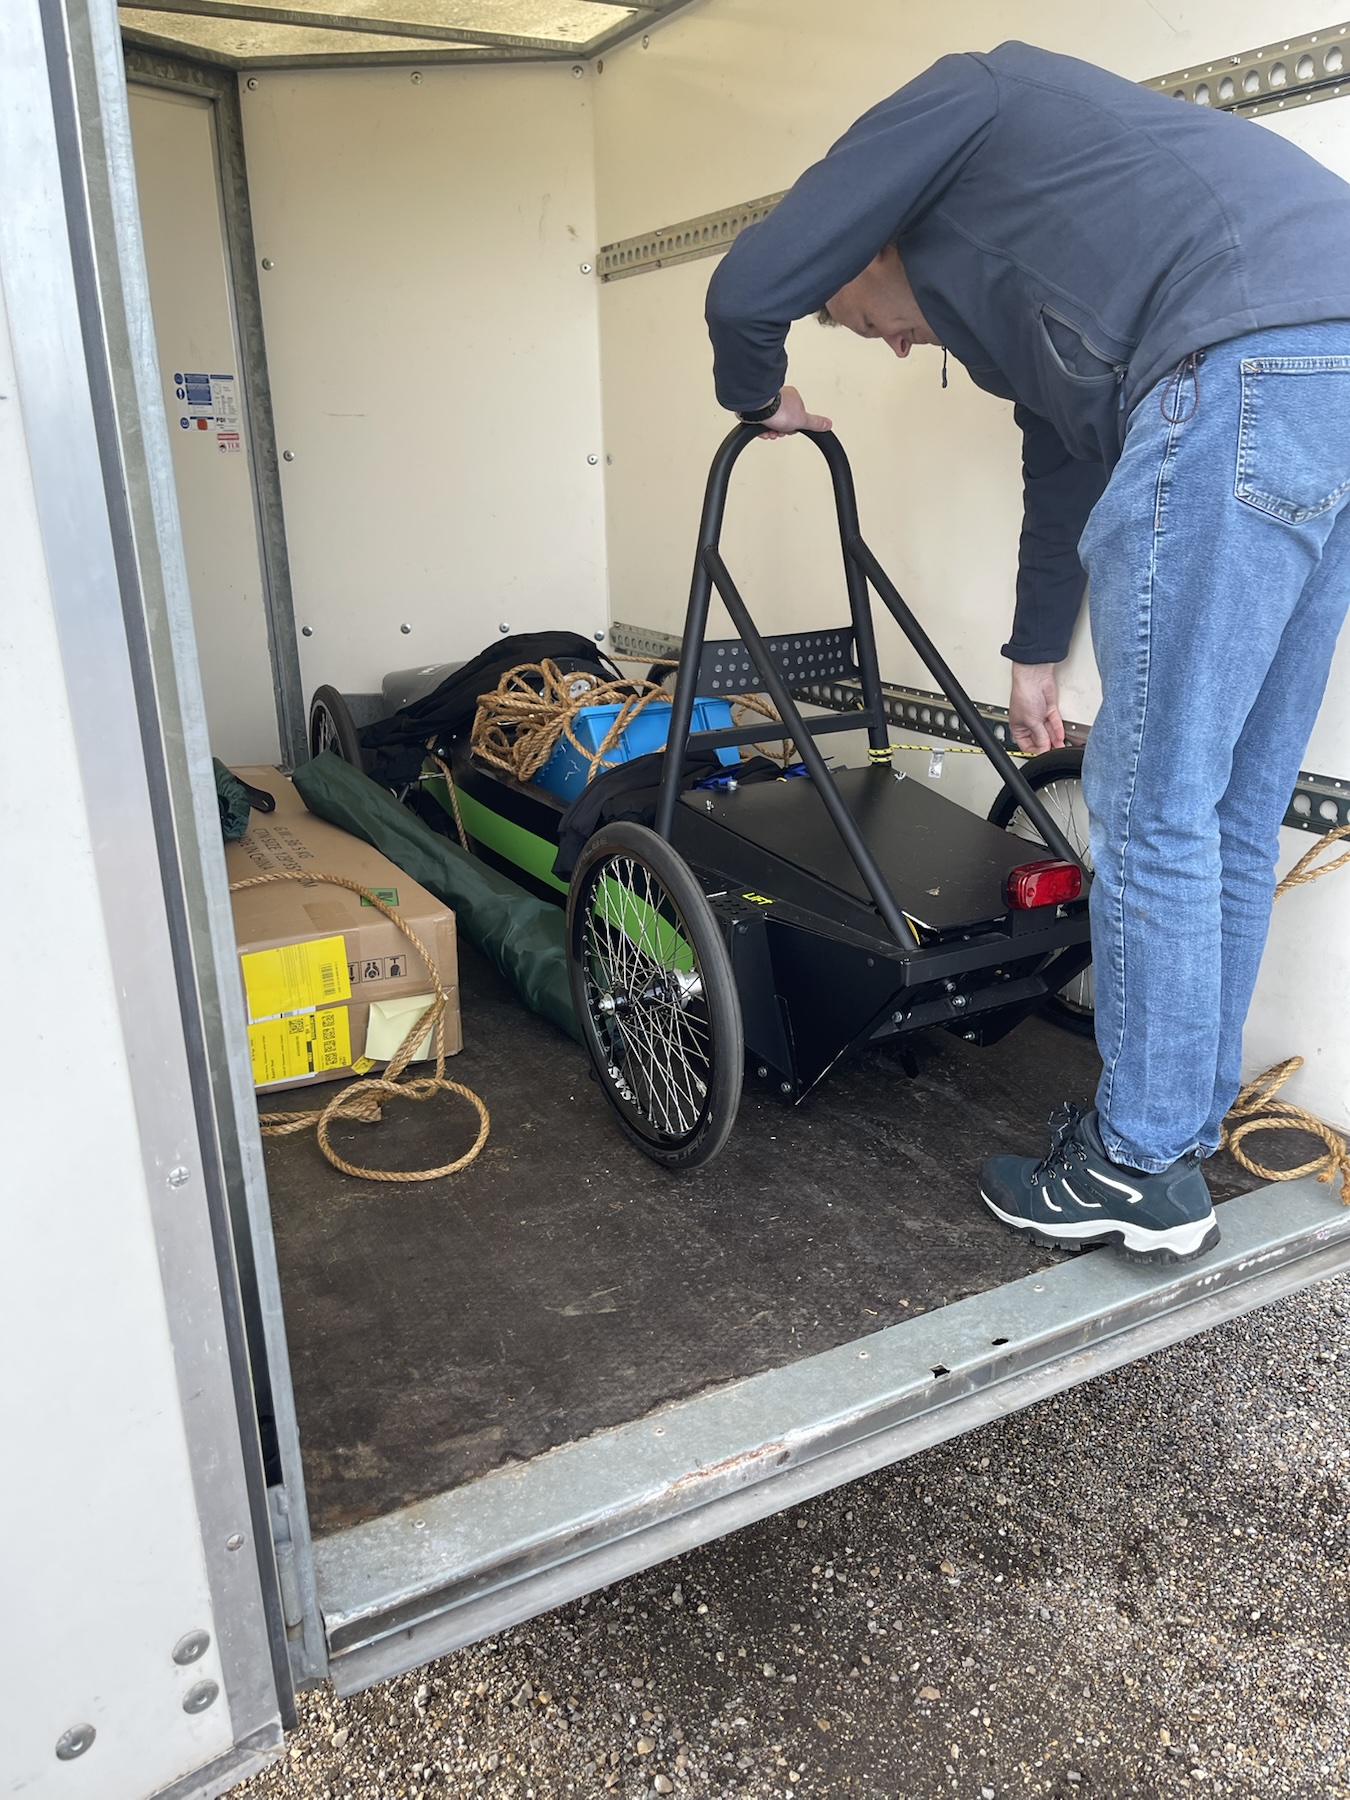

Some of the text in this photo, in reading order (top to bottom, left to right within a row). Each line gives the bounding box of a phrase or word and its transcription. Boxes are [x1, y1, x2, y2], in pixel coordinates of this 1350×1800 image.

[249, 852, 275, 871] CHINA
[742, 892, 774, 905] LIFT
[654, 1128, 708, 1162] KOJAK
